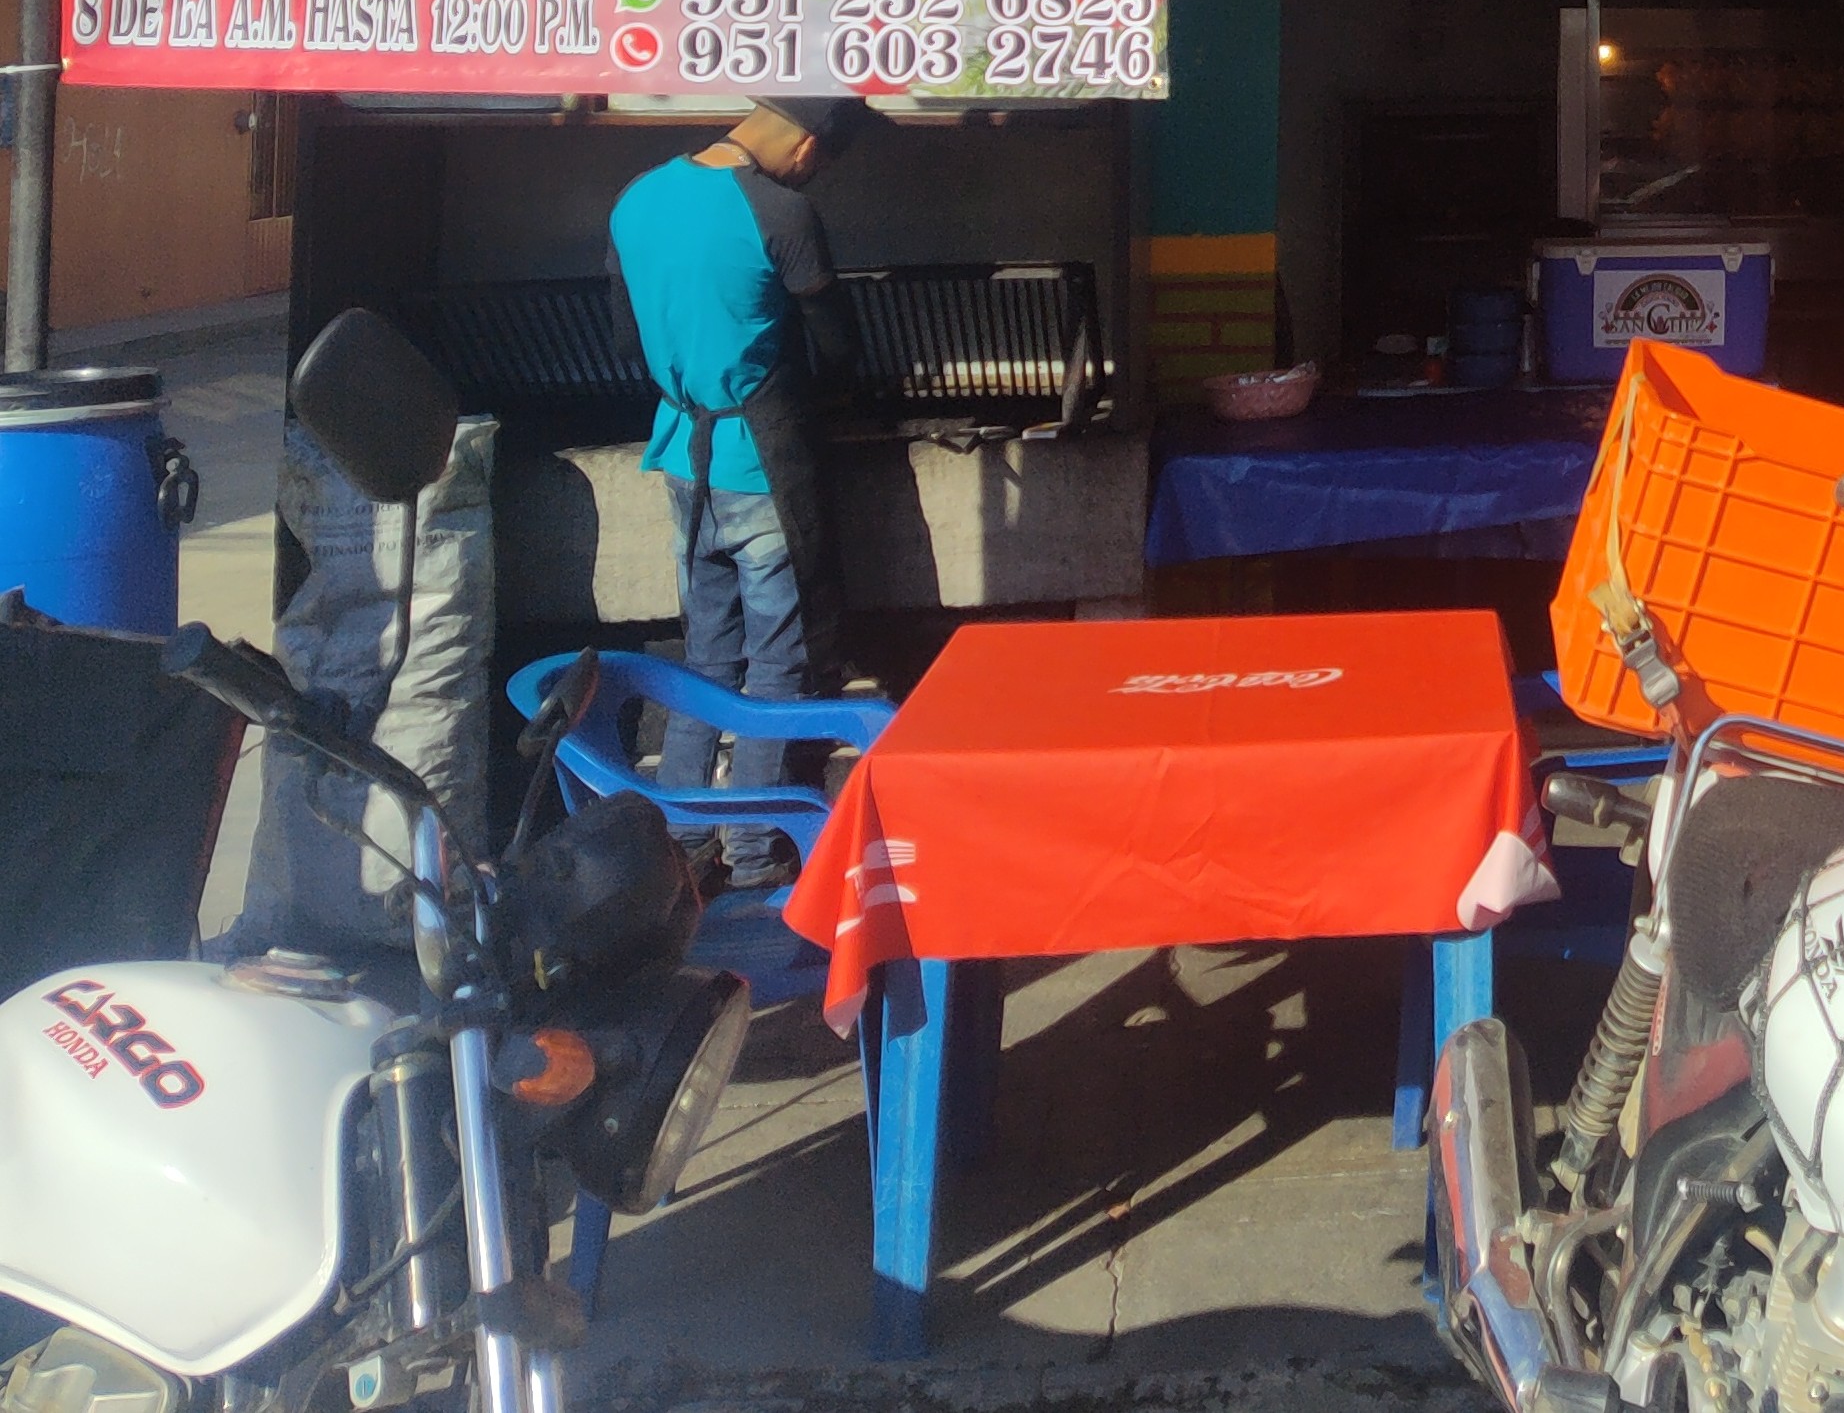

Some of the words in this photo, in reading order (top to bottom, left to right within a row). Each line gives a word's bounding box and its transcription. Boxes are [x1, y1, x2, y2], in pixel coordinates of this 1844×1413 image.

[679, 22, 802, 82] 951
[827, 23, 963, 84] 603
[987, 26, 1156, 85] 2746
[41, 979, 206, 1109] CARGO
[42, 1020, 110, 1080] HONDA
